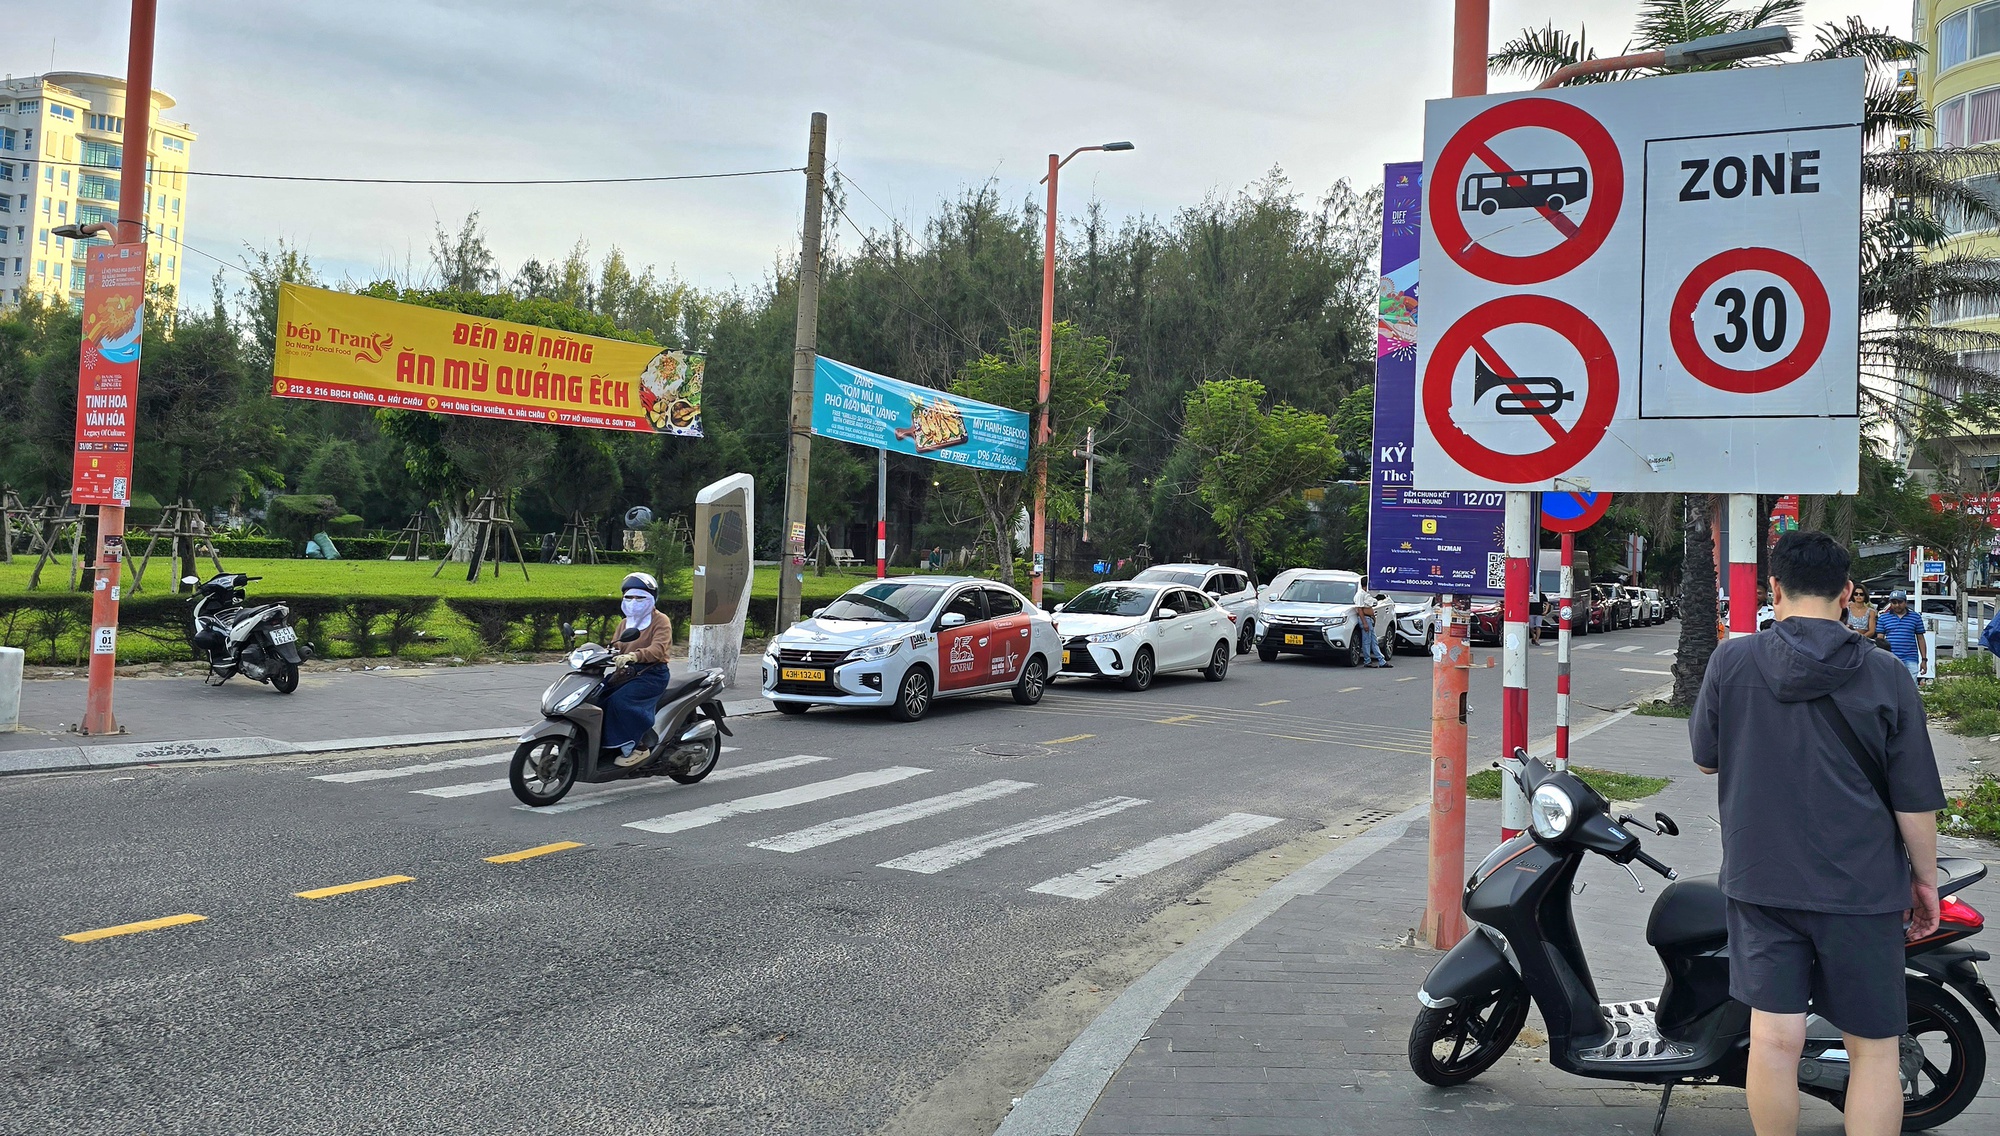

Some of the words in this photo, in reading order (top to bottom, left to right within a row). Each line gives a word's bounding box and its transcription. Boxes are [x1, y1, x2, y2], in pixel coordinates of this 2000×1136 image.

[1679, 150, 1820, 202] ZONE
[1392, 210, 1408, 220] DIFF
[102, 279, 116, 288] 2025
[1714, 286, 1788, 354] 30
[286, 321, 321, 344] bếp
[296, 342, 314, 351] Nang
[452, 322, 498, 350] ĐẾN
[503, 330, 535, 355] ĐÀ
[538, 336, 593, 364] NẴNG
[396, 346, 435, 386] ĂN
[496, 362, 582, 403] QUẢNG
[589, 373, 629, 408] ẾCH
[86, 395, 107, 408] TINH
[108, 395, 127, 408] HOA
[290, 384, 304, 394] 212
[314, 388, 328, 396] 216
[330, 390, 351, 399] BẠCH
[388, 393, 401, 404] HẢI
[402, 397, 423, 406] CHÂU
[456, 402, 469, 411] ÔNG
[484, 406, 507, 415] KHIÊM,
[516, 408, 527, 417] HẢI
[528, 410, 545, 418] CHÂU
[86, 410, 104, 426] VĂN
[106, 410, 125, 426] HÓA
[1002, 425, 1027, 439] SEAFOOD
[940, 449, 952, 459] GET
[953, 450, 969, 463] FREE!
[977, 450, 990, 460] 096
[990, 452, 1001, 463] 774
[1001, 454, 1017, 466] 8668
[1381, 442, 1407, 462] KỶ
[1381, 469, 1407, 481] The
[1462, 493, 1503, 506] 12/07
[914, 633, 927, 644] DANA
[950, 662, 974, 673] GENERALI
[786, 671, 822, 679] 43H-132.40
